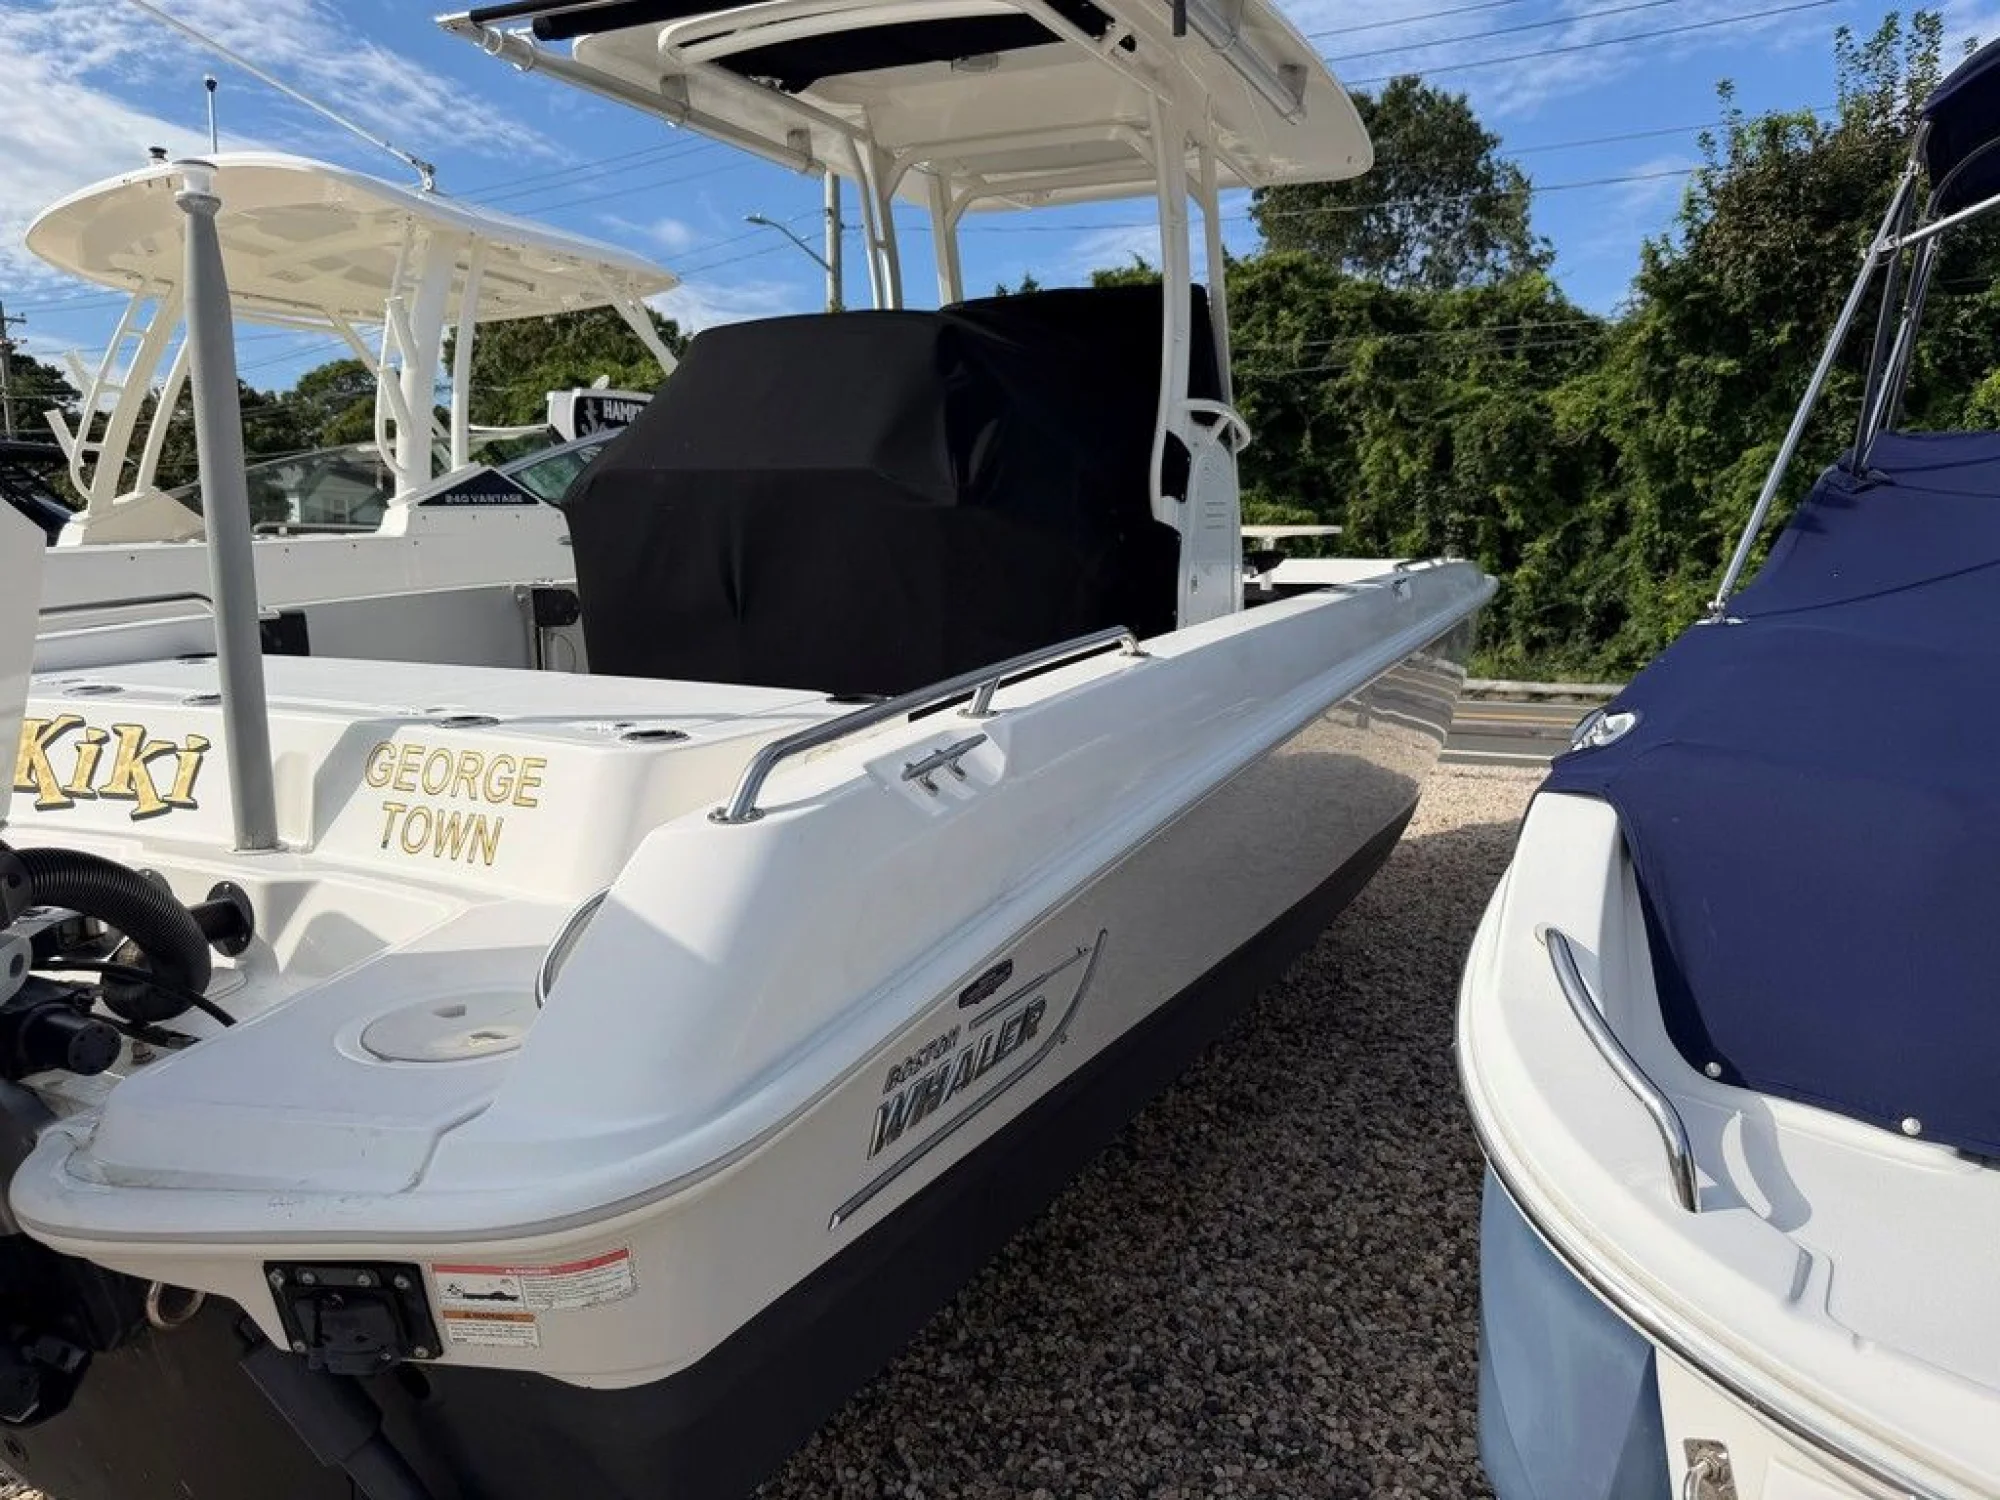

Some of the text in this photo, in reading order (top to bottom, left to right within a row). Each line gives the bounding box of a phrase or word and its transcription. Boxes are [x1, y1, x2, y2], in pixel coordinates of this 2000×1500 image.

[365, 741, 548, 808] GEORGE
[380, 801, 504, 866] TOWN
[867, 996, 1047, 1160] WHALER
[883, 1024, 961, 1094] BOSTON
